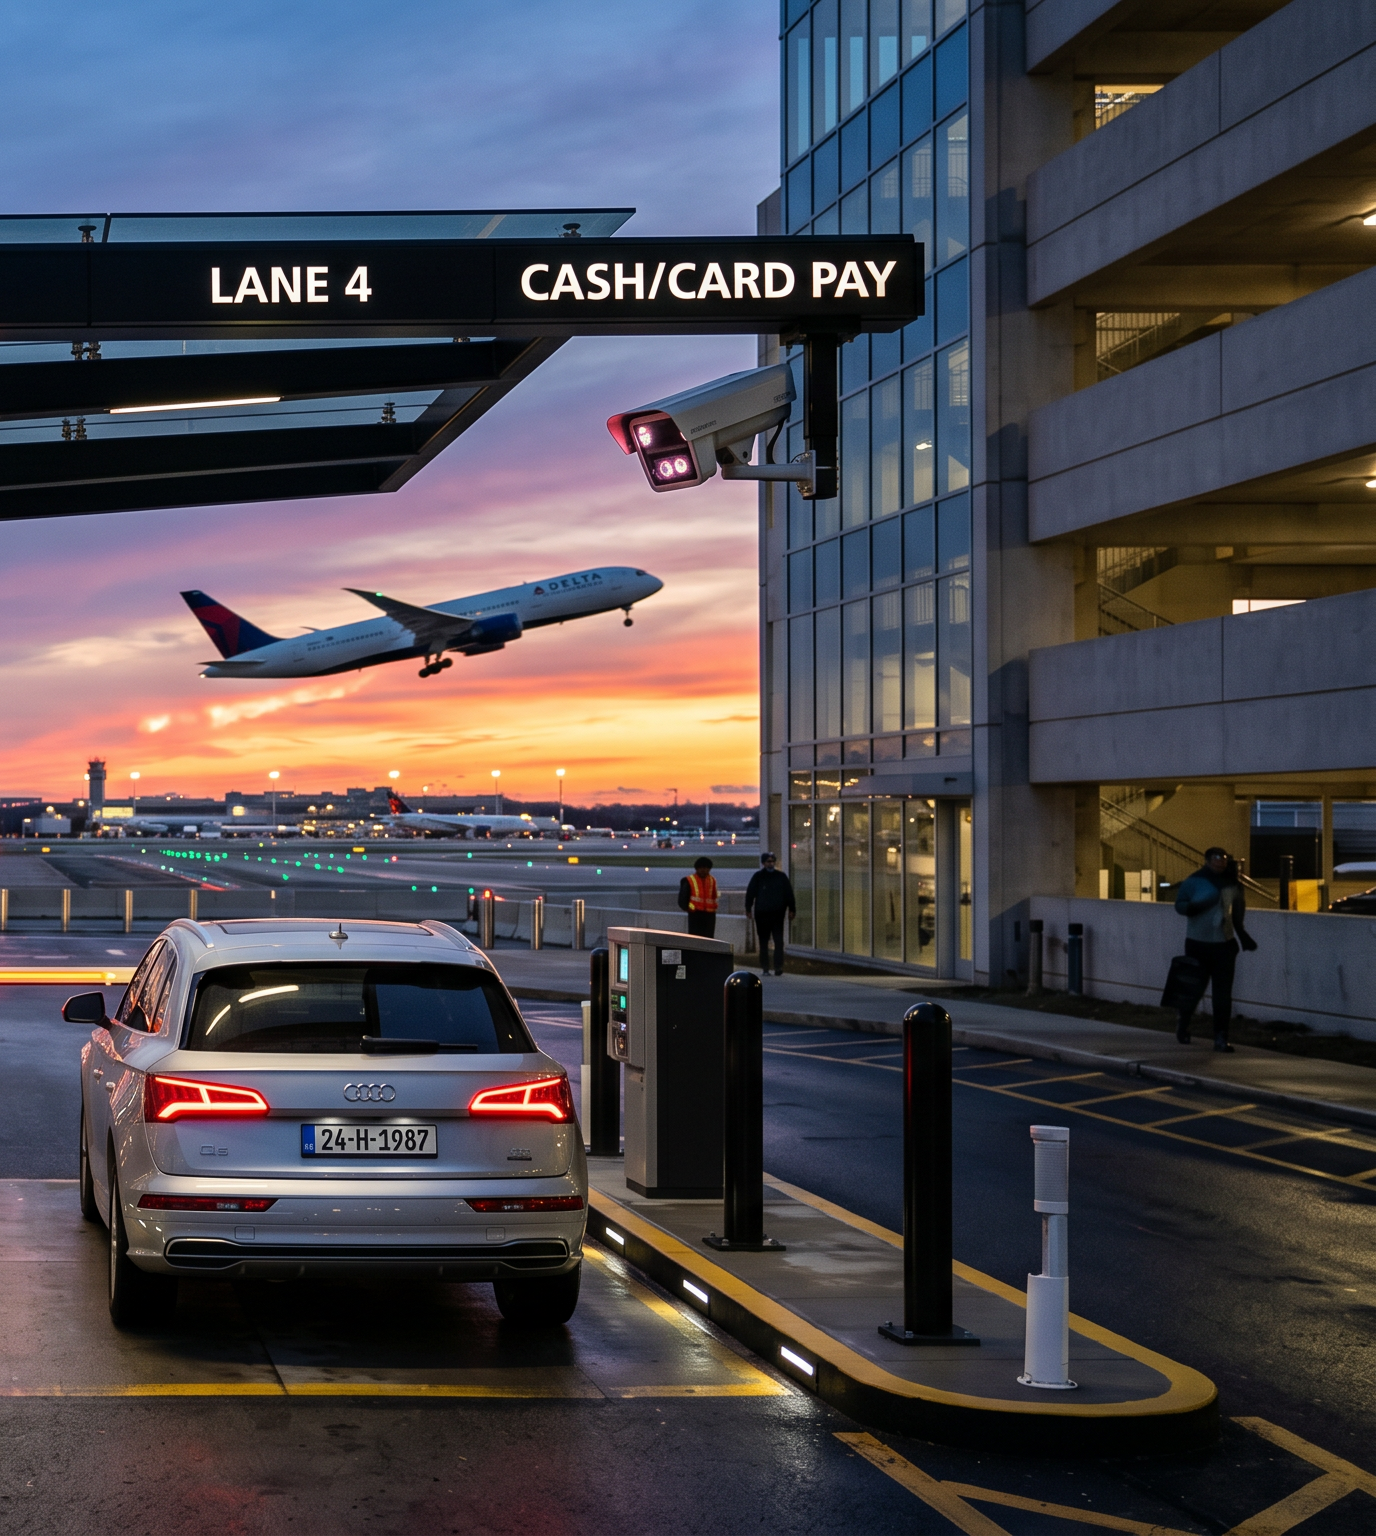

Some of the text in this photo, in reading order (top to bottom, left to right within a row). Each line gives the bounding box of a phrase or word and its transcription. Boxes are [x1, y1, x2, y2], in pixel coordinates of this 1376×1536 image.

[211, 266, 373, 304] LANE 4
[521, 261, 898, 301] CASH/CARD PAY
[548, 573, 602, 590] DELTA
[321, 1128, 429, 1151] 24-H-1987
